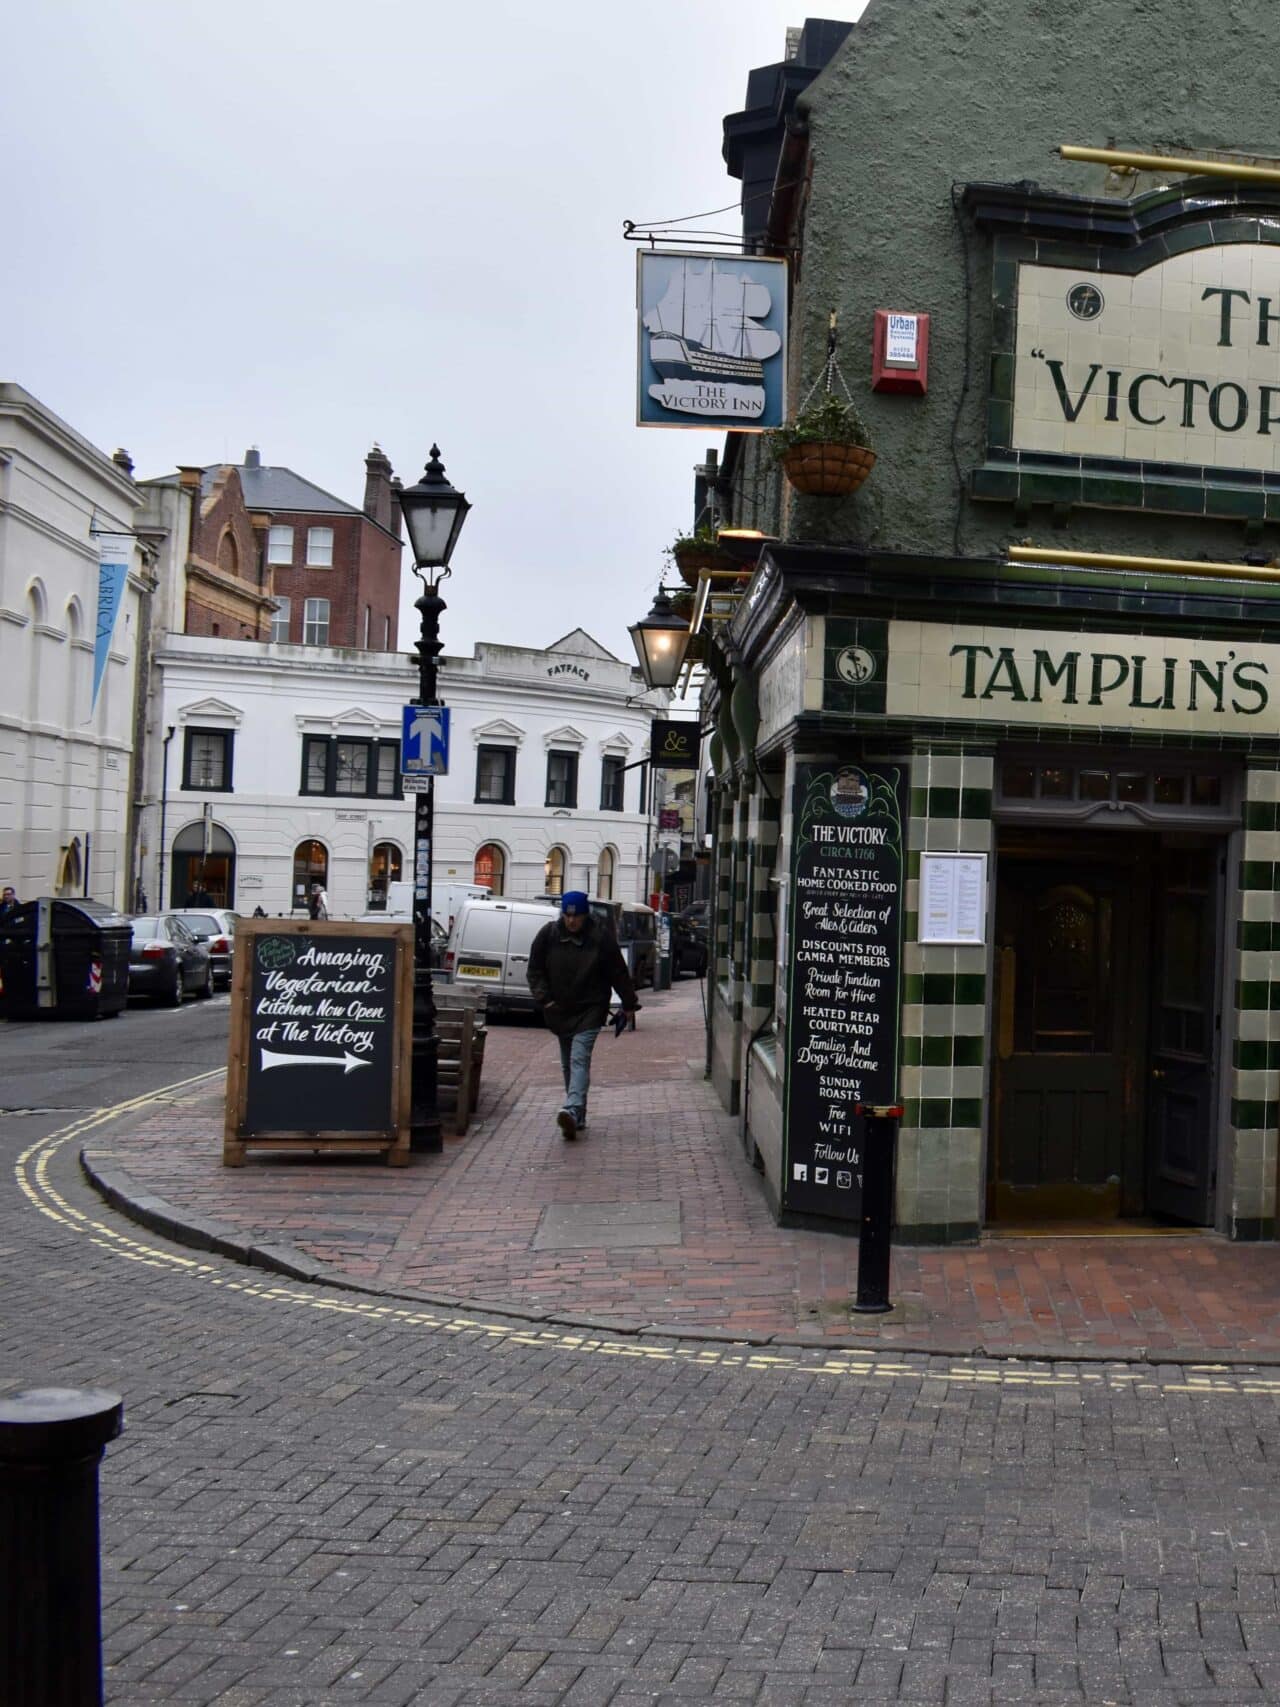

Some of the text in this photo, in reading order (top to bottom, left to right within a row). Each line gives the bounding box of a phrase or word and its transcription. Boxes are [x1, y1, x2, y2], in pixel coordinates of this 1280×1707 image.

[891, 317, 914, 330] Urban
[695, 385, 726, 398] THE
[662, 394, 762, 411] VICTORY INN
[547, 664, 589, 681] FATFACE
[948, 643, 1268, 714] TAMPLIN'S
[812, 825, 887, 845] THE VICTORY
[820, 846, 850, 858] CIRCA
[813, 866, 879, 881] FANTASTIC
[798, 878, 897, 893] HOME COOKED FOOD
[803, 902, 891, 925] Great Selection of
[815, 919, 877, 935] Ales & Ciders
[802, 940, 886, 956] DISCOUNTS FOR
[297, 947, 385, 978] Amazing
[797, 952, 890, 967] CAMRA MEMBERS
[261, 970, 385, 999] Vegetarian
[808, 967, 880, 987] Private Function
[805, 983, 830, 999] Room
[851, 989, 876, 1003] Hire
[256, 997, 385, 1021] Kitchen Now Open
[803, 1006, 879, 1023] HEATED REAR
[809, 1020, 873, 1035] COURTYARD
[256, 1021, 374, 1052] at The Victory
[809, 1035, 871, 1056] Families And
[797, 1047, 879, 1071] Dogs Welcome
[819, 1075, 861, 1089] SUNDAY
[819, 1088, 861, 1100] ROASTS
[828, 1105, 846, 1121] Free
[819, 1122, 851, 1136] WIFI
[814, 1143, 859, 1164] Follow Us
